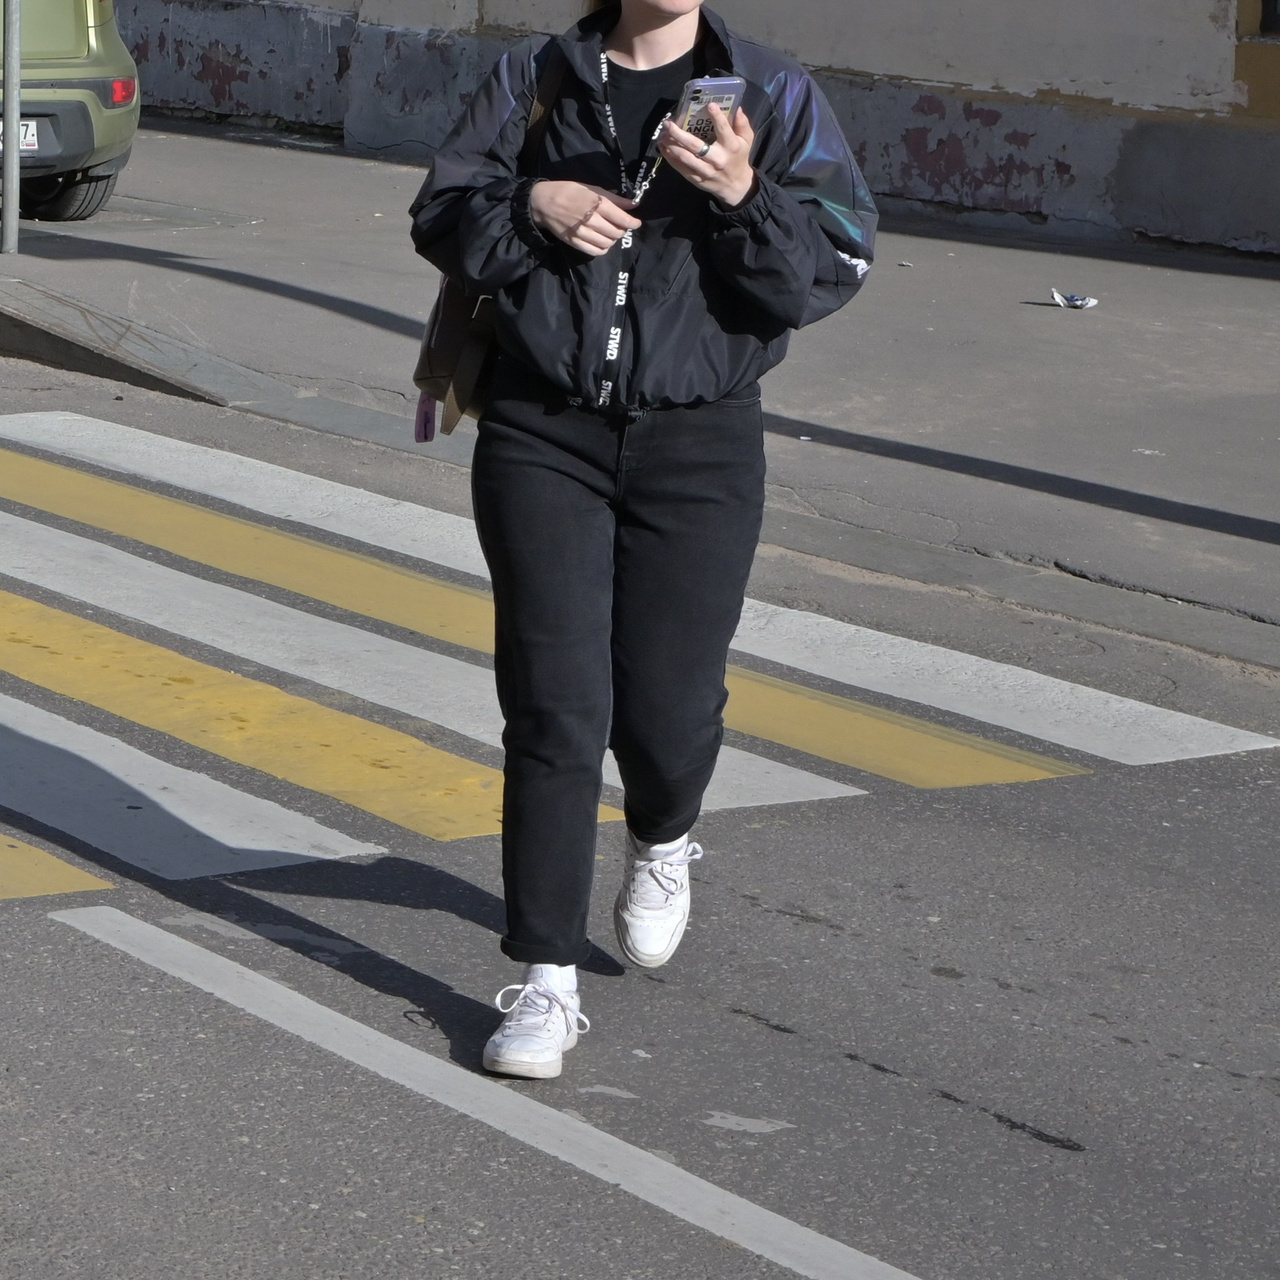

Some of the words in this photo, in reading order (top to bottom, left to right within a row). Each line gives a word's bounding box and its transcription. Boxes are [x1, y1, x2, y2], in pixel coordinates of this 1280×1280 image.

[687, 118, 712, 126] LOS
[615, 271, 629, 306] STWD.
[605, 326, 621, 361] STWD.
